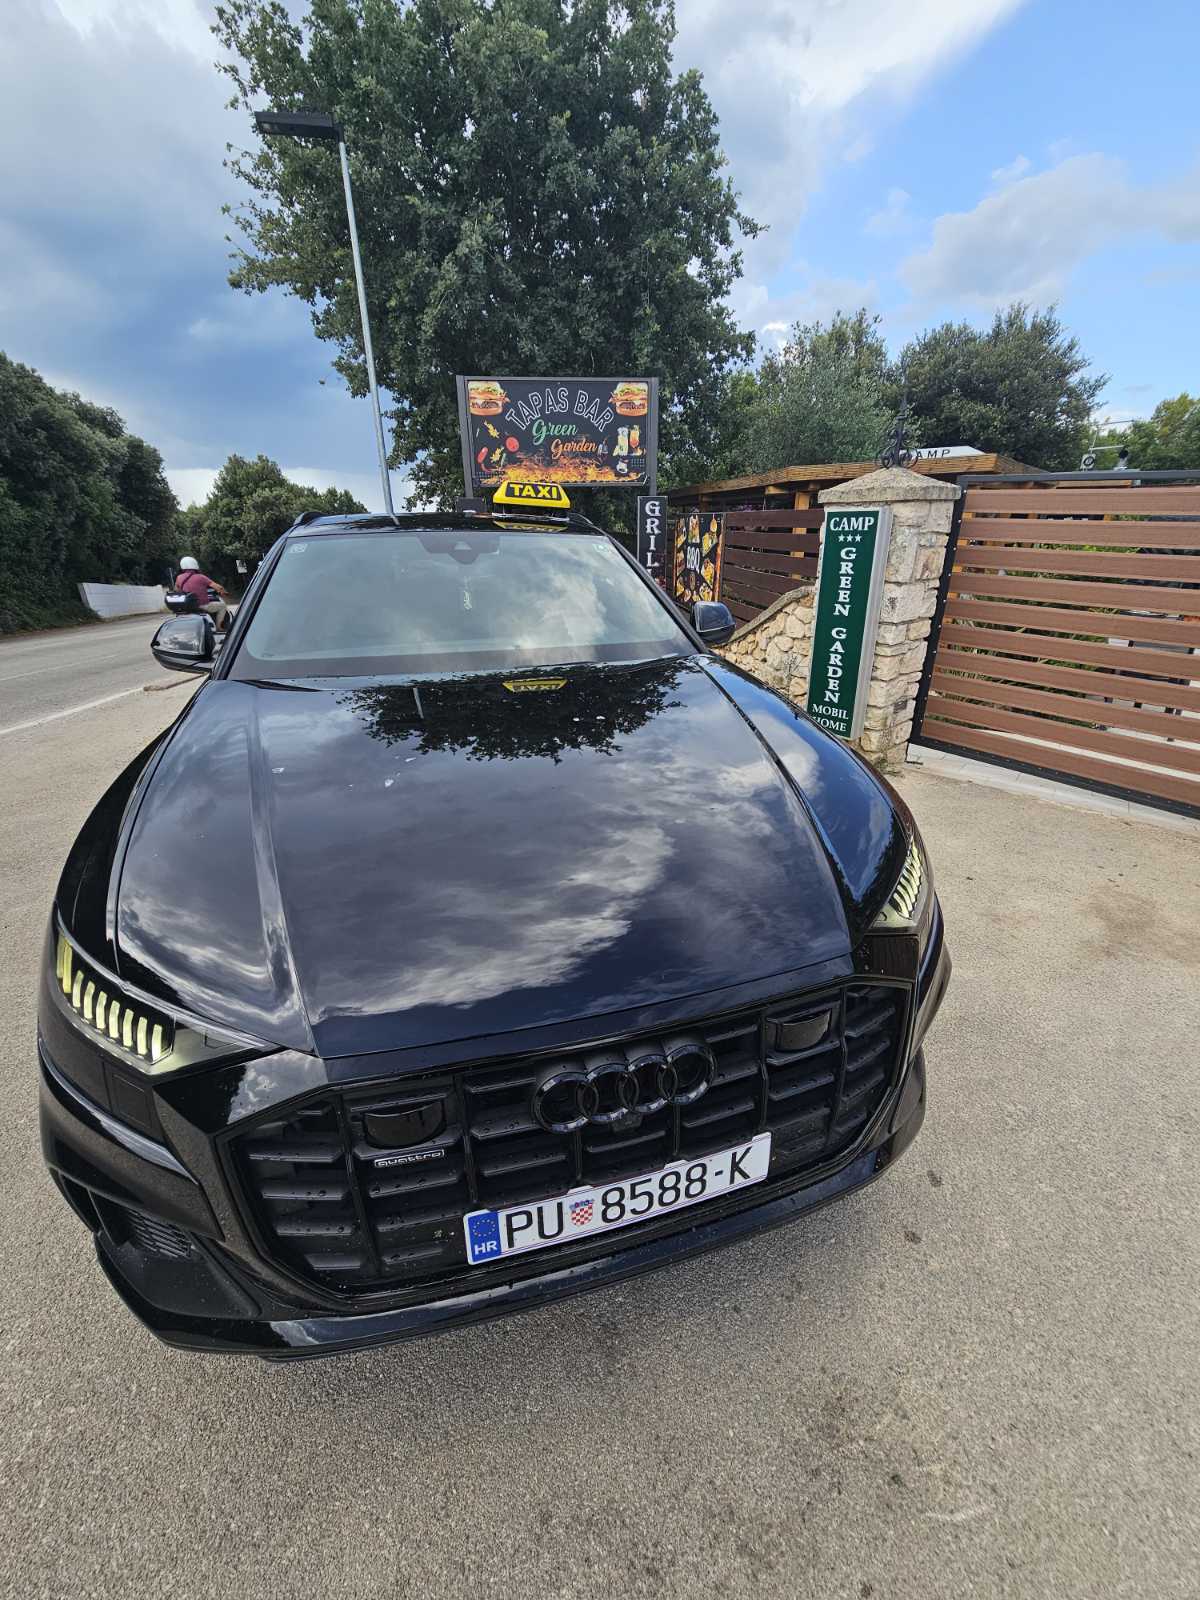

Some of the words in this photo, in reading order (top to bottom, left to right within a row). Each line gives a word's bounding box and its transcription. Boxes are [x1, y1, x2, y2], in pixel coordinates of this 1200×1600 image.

[505, 388, 569, 430] TAPAS
[574, 390, 614, 432] BAR
[532, 419, 577, 445] Green
[551, 437, 598, 460] Garden
[914, 448, 950, 459] AMP
[510, 484, 558, 499] TAXI
[830, 517, 875, 531] CAMP
[645, 501, 661, 576] GRIL
[686, 546, 700, 574] BBQ
[833, 547, 857, 616] GREEN
[824, 627, 847, 703] GARDEN
[812, 703, 849, 720] MOBIL
[505, 1201, 564, 1249] PU
[474, 1240, 498, 1256] HR
